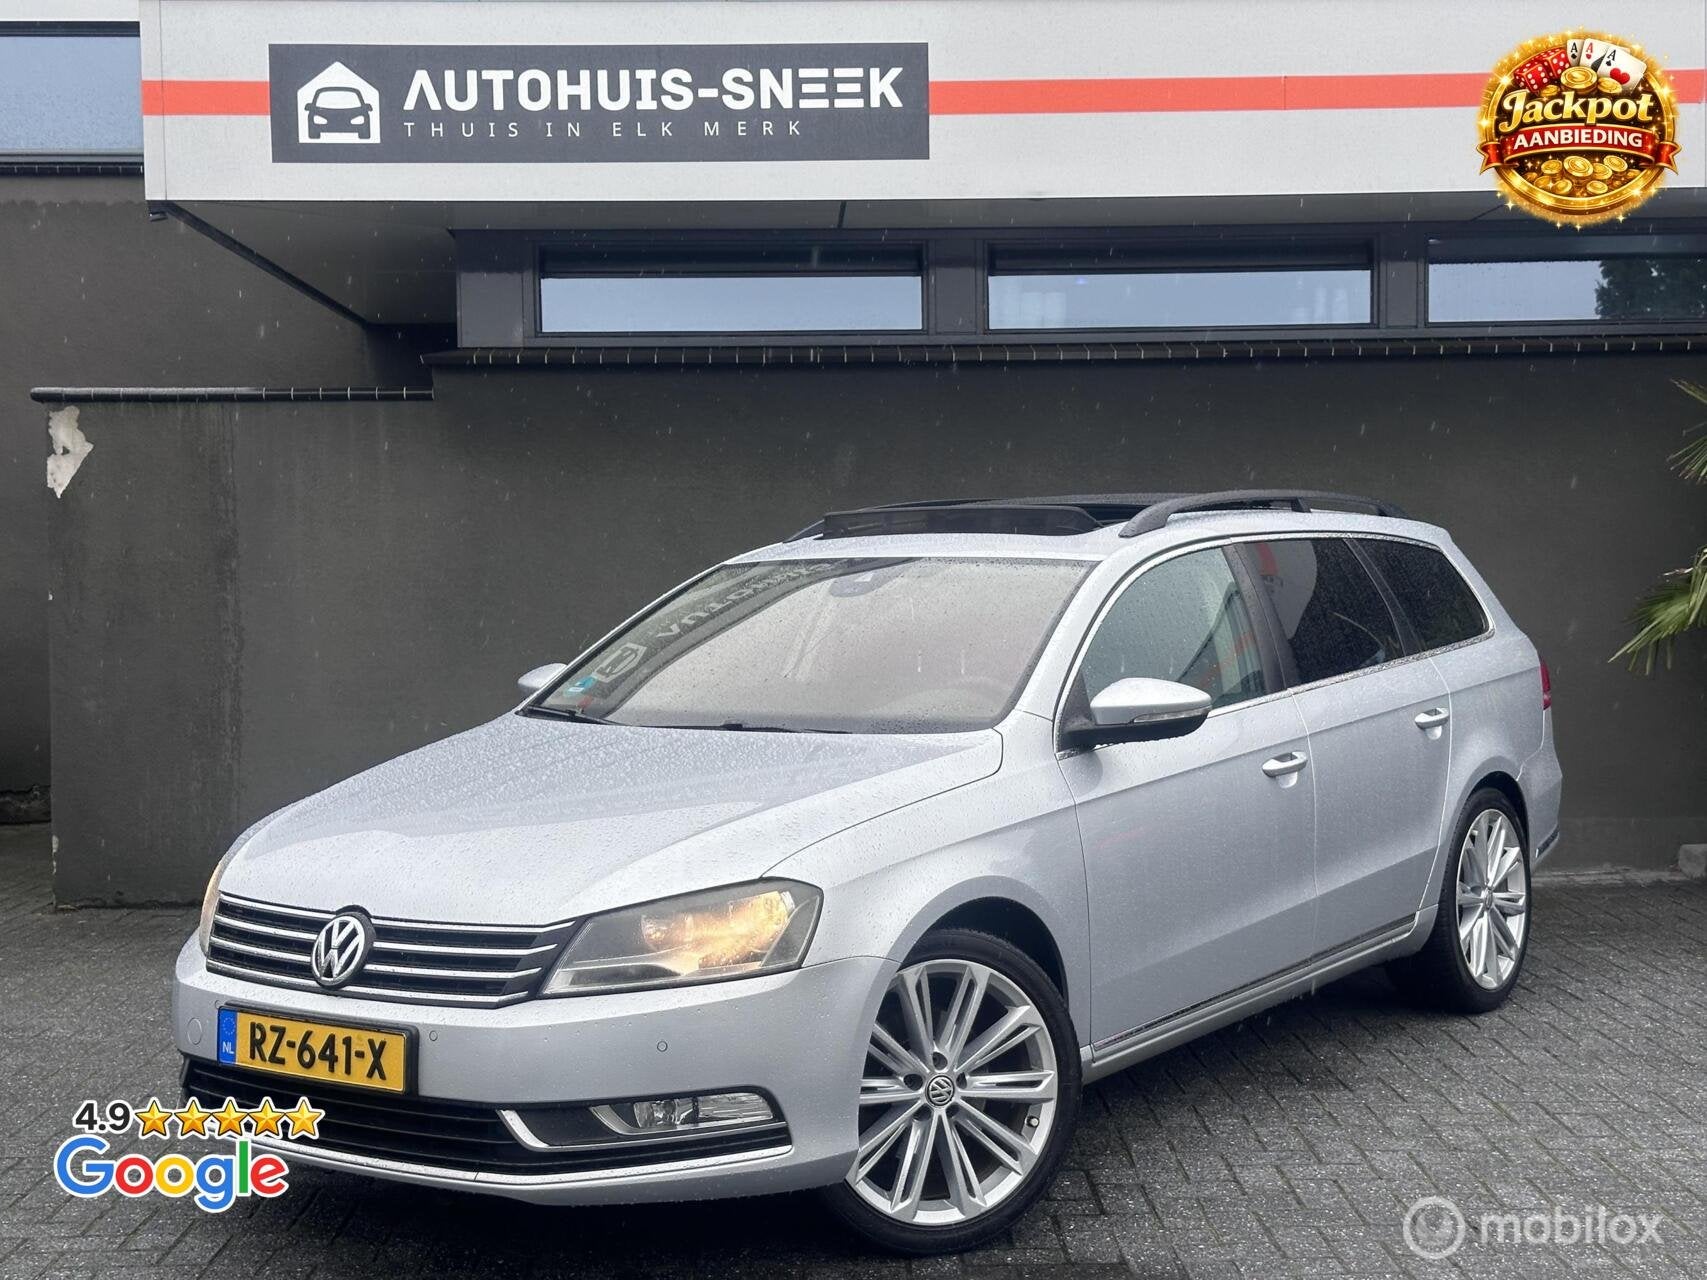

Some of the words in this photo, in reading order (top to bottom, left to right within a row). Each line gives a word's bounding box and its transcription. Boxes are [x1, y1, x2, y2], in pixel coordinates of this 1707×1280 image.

[403, 67, 903, 111] AUTOHUIS-SNEEK
[404, 122, 519, 138] THUIS
[546, 122, 581, 137] IN
[613, 122, 673, 137] ELK
[704, 121, 800, 137] MERK
[222, 1041, 235, 1054] NL
[249, 1021, 387, 1080] RZ-641-X
